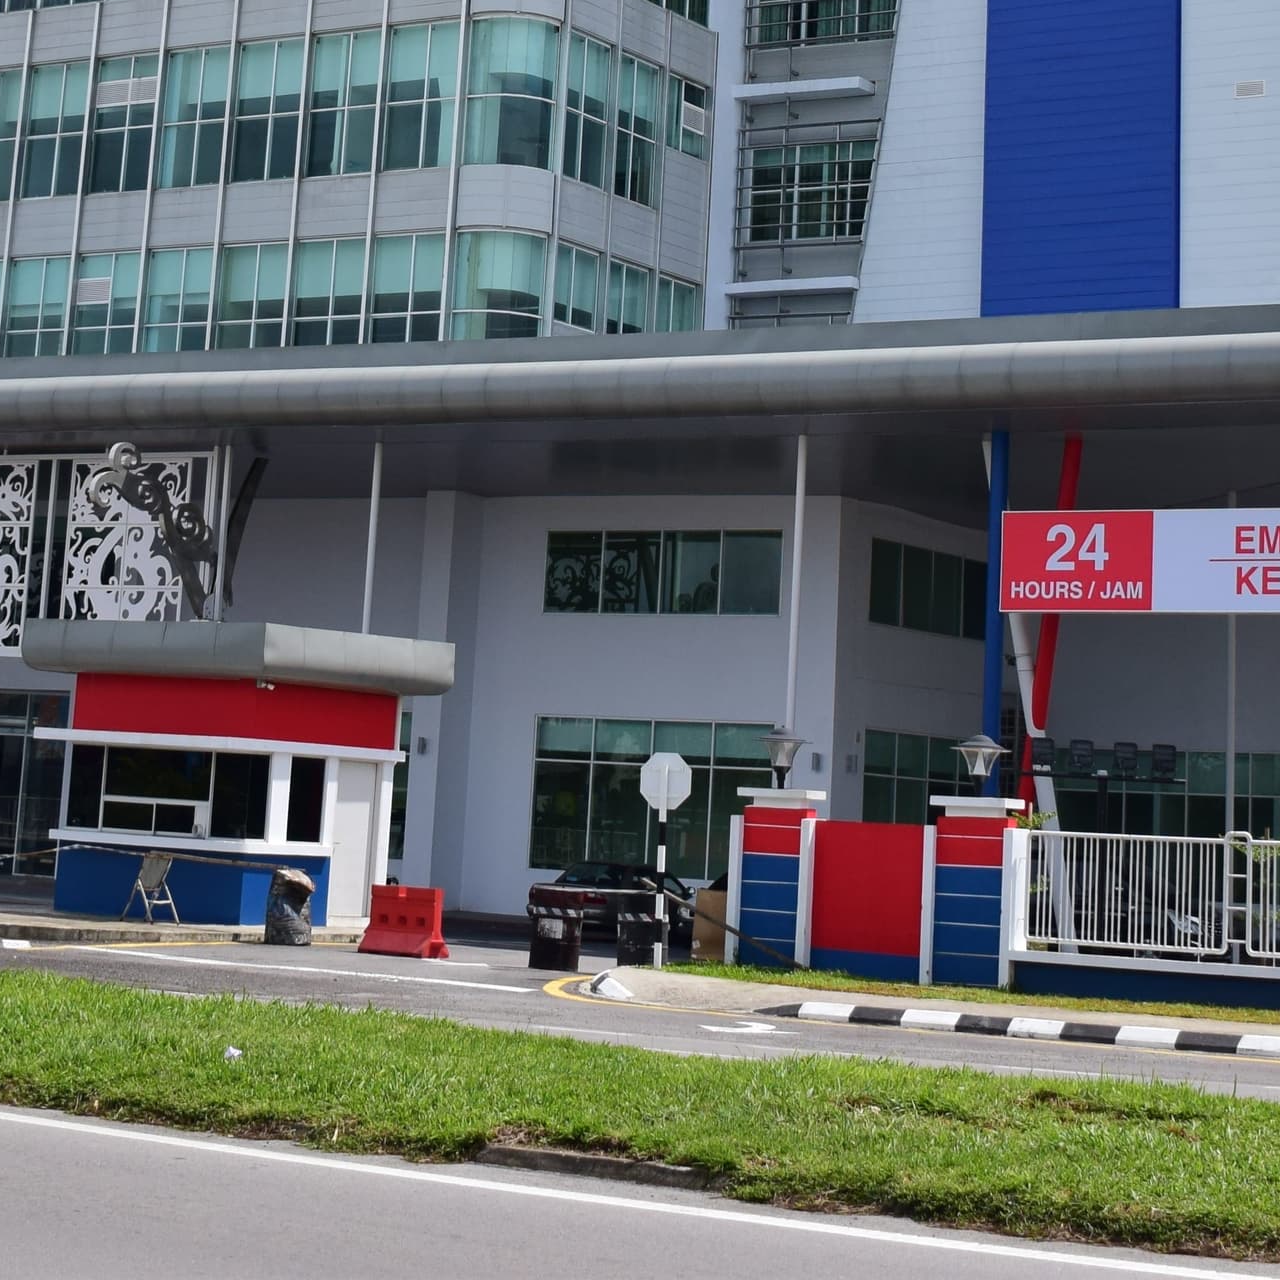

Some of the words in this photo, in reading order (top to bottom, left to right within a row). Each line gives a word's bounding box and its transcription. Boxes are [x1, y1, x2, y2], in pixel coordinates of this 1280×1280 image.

[1045, 523, 1110, 571] 24
[1010, 581, 1083, 599] HOURS
[1087, 581, 1096, 599] /
[1100, 581, 1143, 599] JAM
